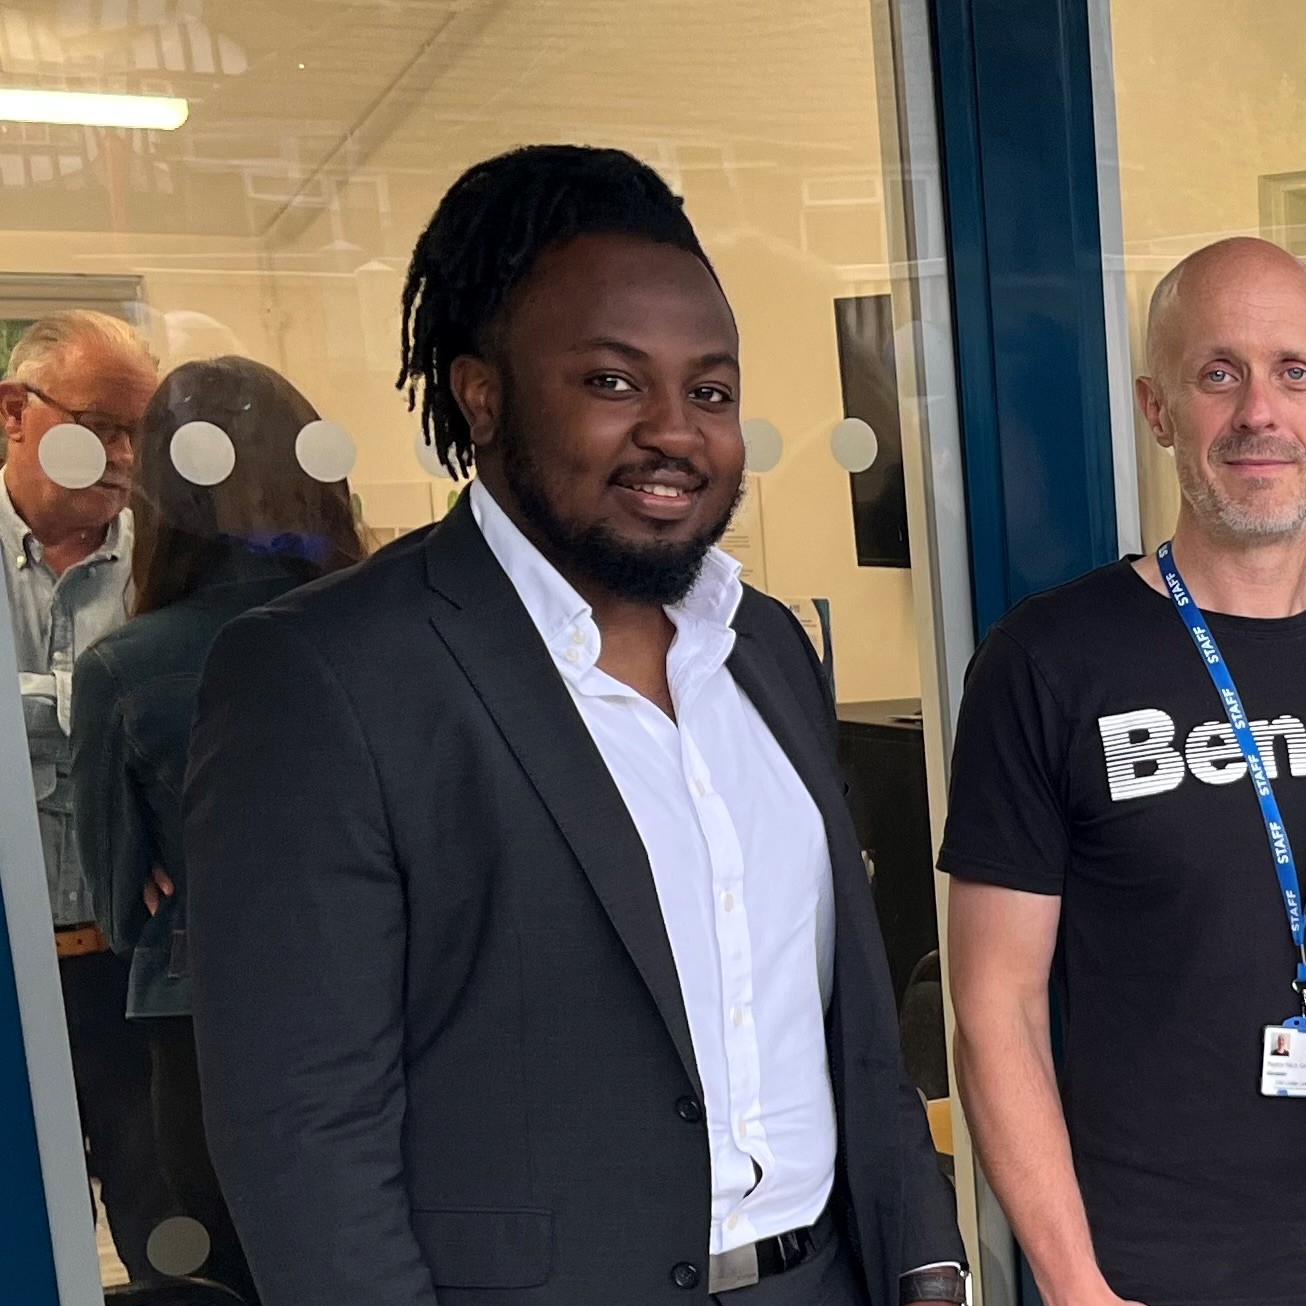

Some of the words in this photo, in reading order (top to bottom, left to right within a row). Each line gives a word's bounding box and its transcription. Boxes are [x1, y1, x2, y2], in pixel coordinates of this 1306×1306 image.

[1165, 572, 1189, 607] STAFF
[1192, 626, 1219, 664] STAFF
[1222, 688, 1246, 730] STAFF
[1247, 754, 1270, 796] STAFF
[1269, 822, 1289, 865] STAFF
[1286, 890, 1300, 932] STAFF
